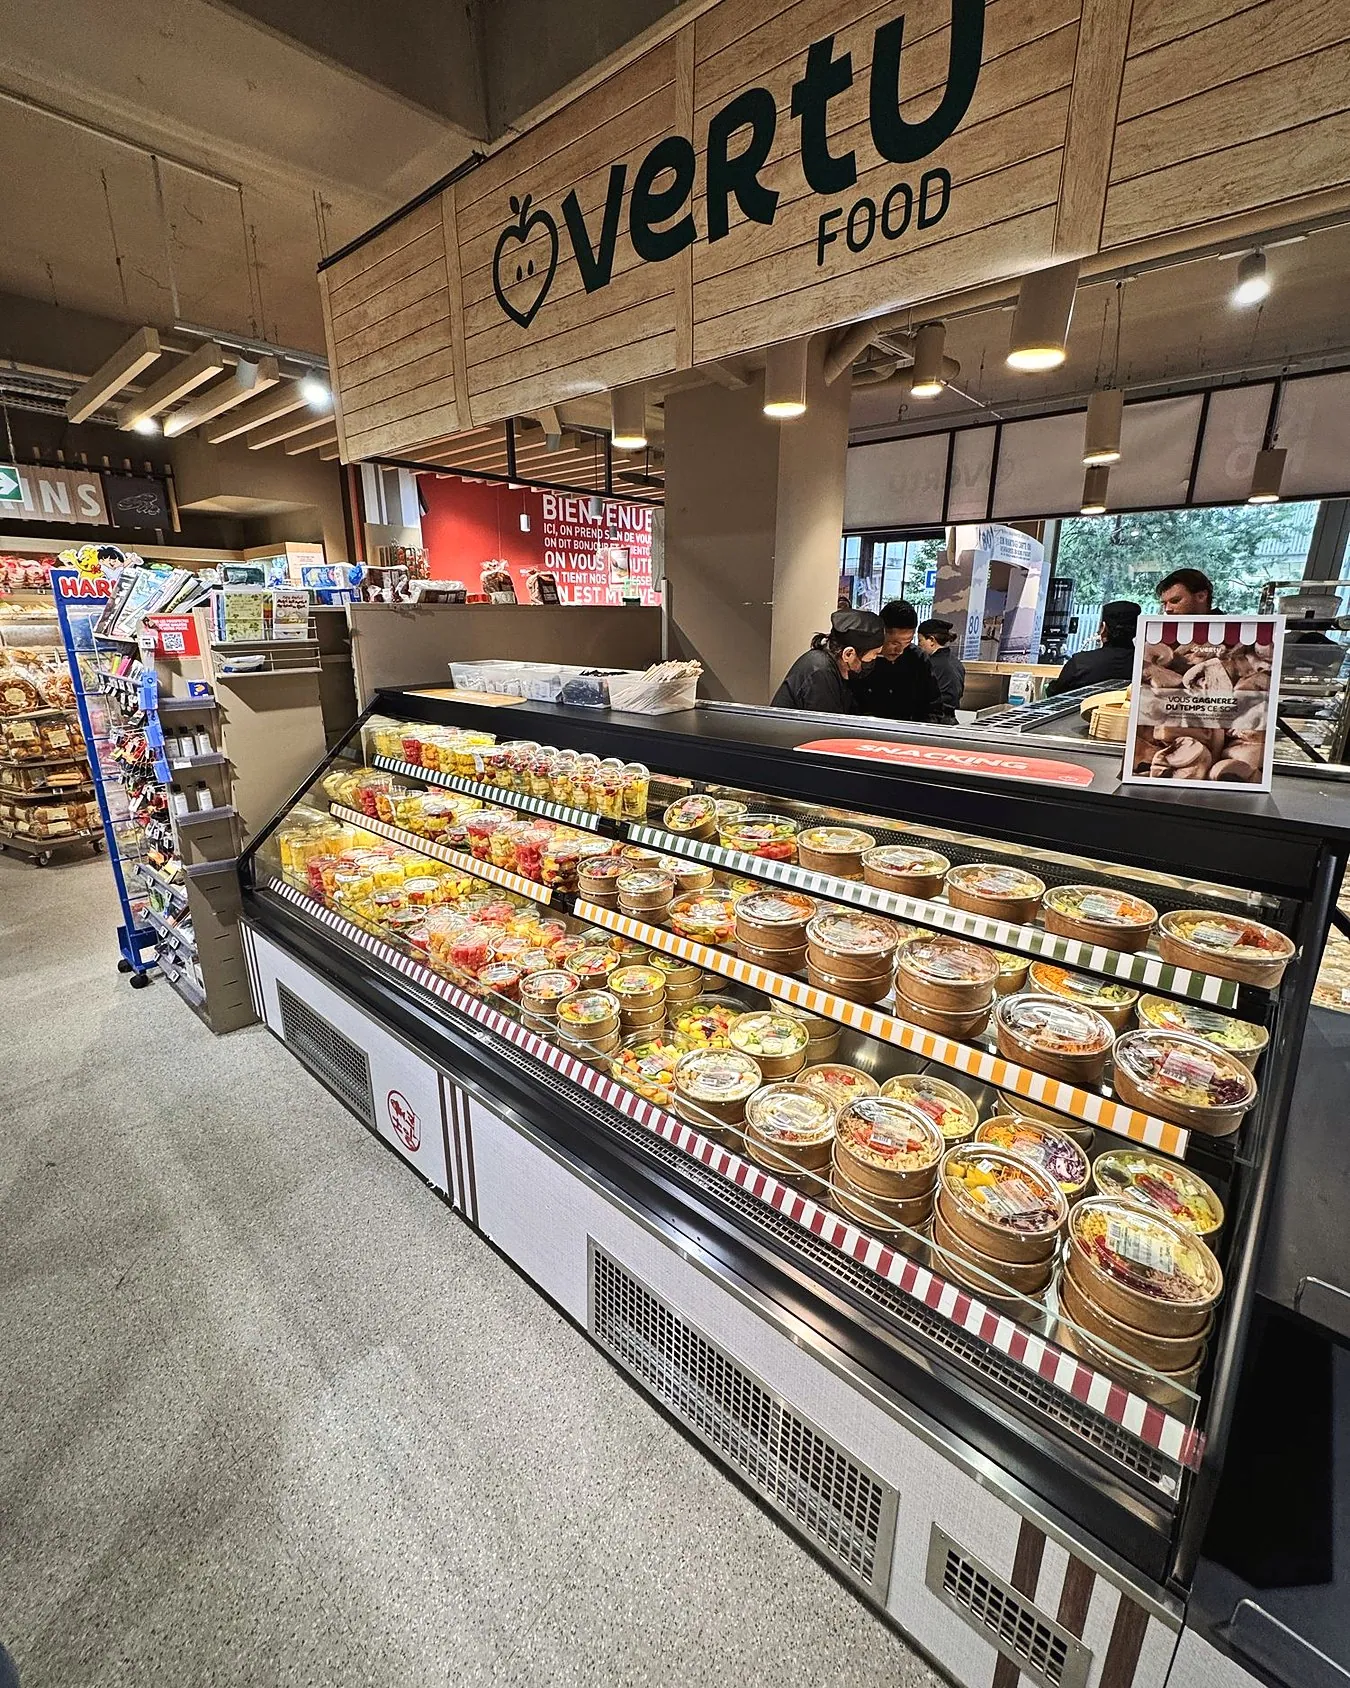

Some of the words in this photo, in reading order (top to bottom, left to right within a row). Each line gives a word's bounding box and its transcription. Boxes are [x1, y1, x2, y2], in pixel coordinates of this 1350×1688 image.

[816, 167, 951, 266] FOOD
[4, 478, 100, 516] INS
[543, 522, 558, 536] ICI,
[560, 524, 573, 537] ON
[574, 526, 603, 539] PREND
[624, 532, 634, 543] DE
[544, 537, 556, 548] ON
[558, 538, 571, 549] DIT
[545, 550, 566, 568] ON
[569, 552, 605, 571] VOUS
[561, 571, 588, 583] TIENT
[590, 573, 607, 585] NOS
[574, 586, 601, 604] EST
[968, 615, 979, 635] 80
[1168, 696, 1190, 704] VOUS
[1192, 696, 1238, 705] GAGNEREZ
[1180, 704, 1206, 712] TEMPS
[855, 744, 1028, 770] SNACKING
